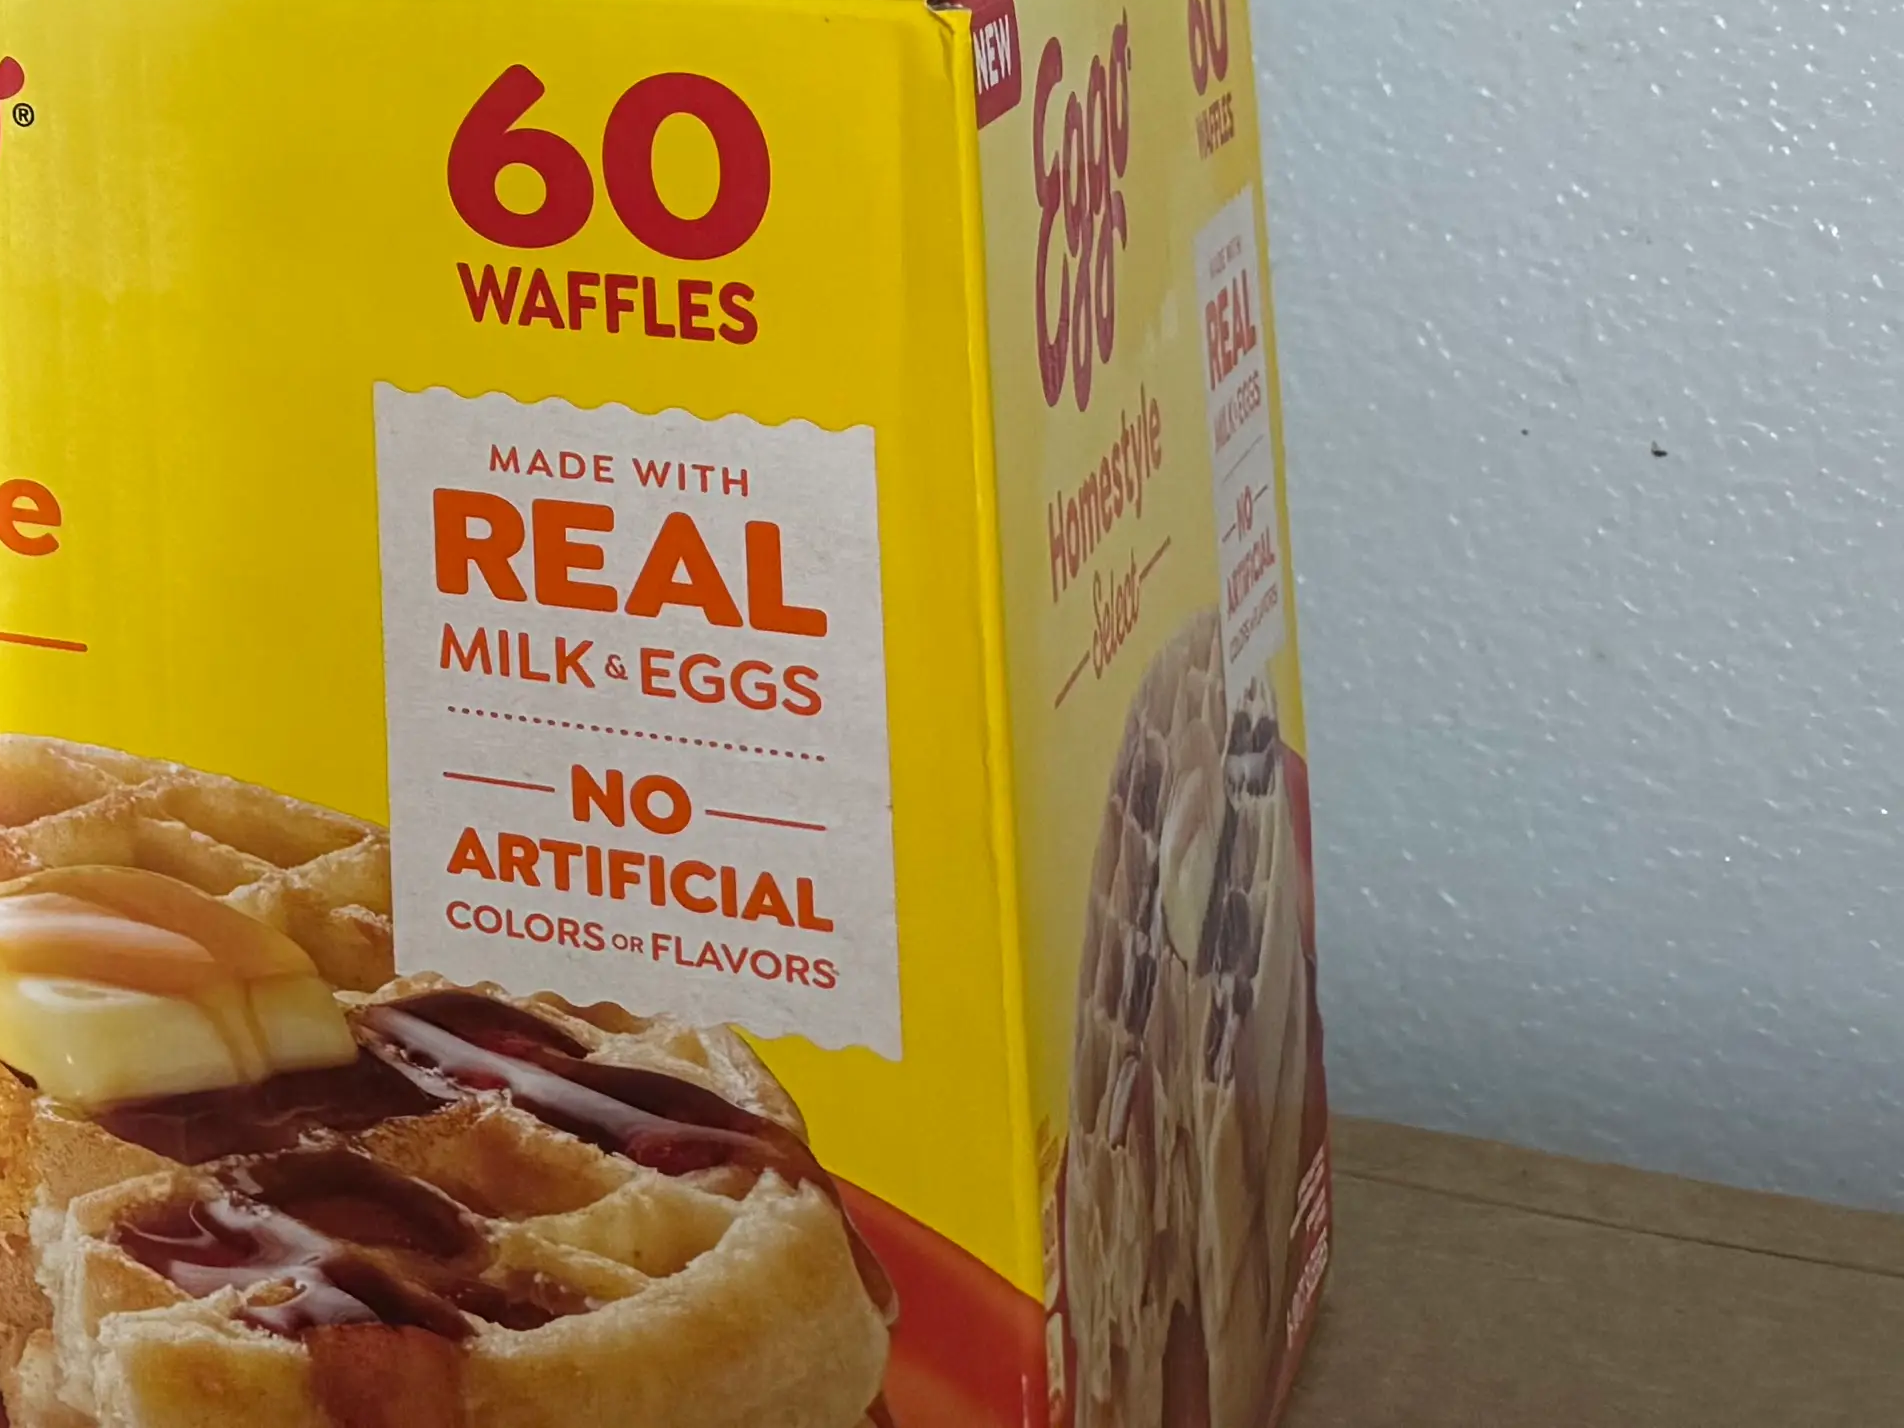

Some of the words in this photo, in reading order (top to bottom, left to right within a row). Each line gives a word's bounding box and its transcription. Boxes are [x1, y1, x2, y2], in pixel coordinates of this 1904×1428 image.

[452, 65, 767, 261] 60
[460, 263, 754, 345] WAFFLES
[435, 488, 824, 637] REAL
[1049, 380, 1162, 604] Homestyle
[447, 828, 831, 932] ARTIFICIAL
